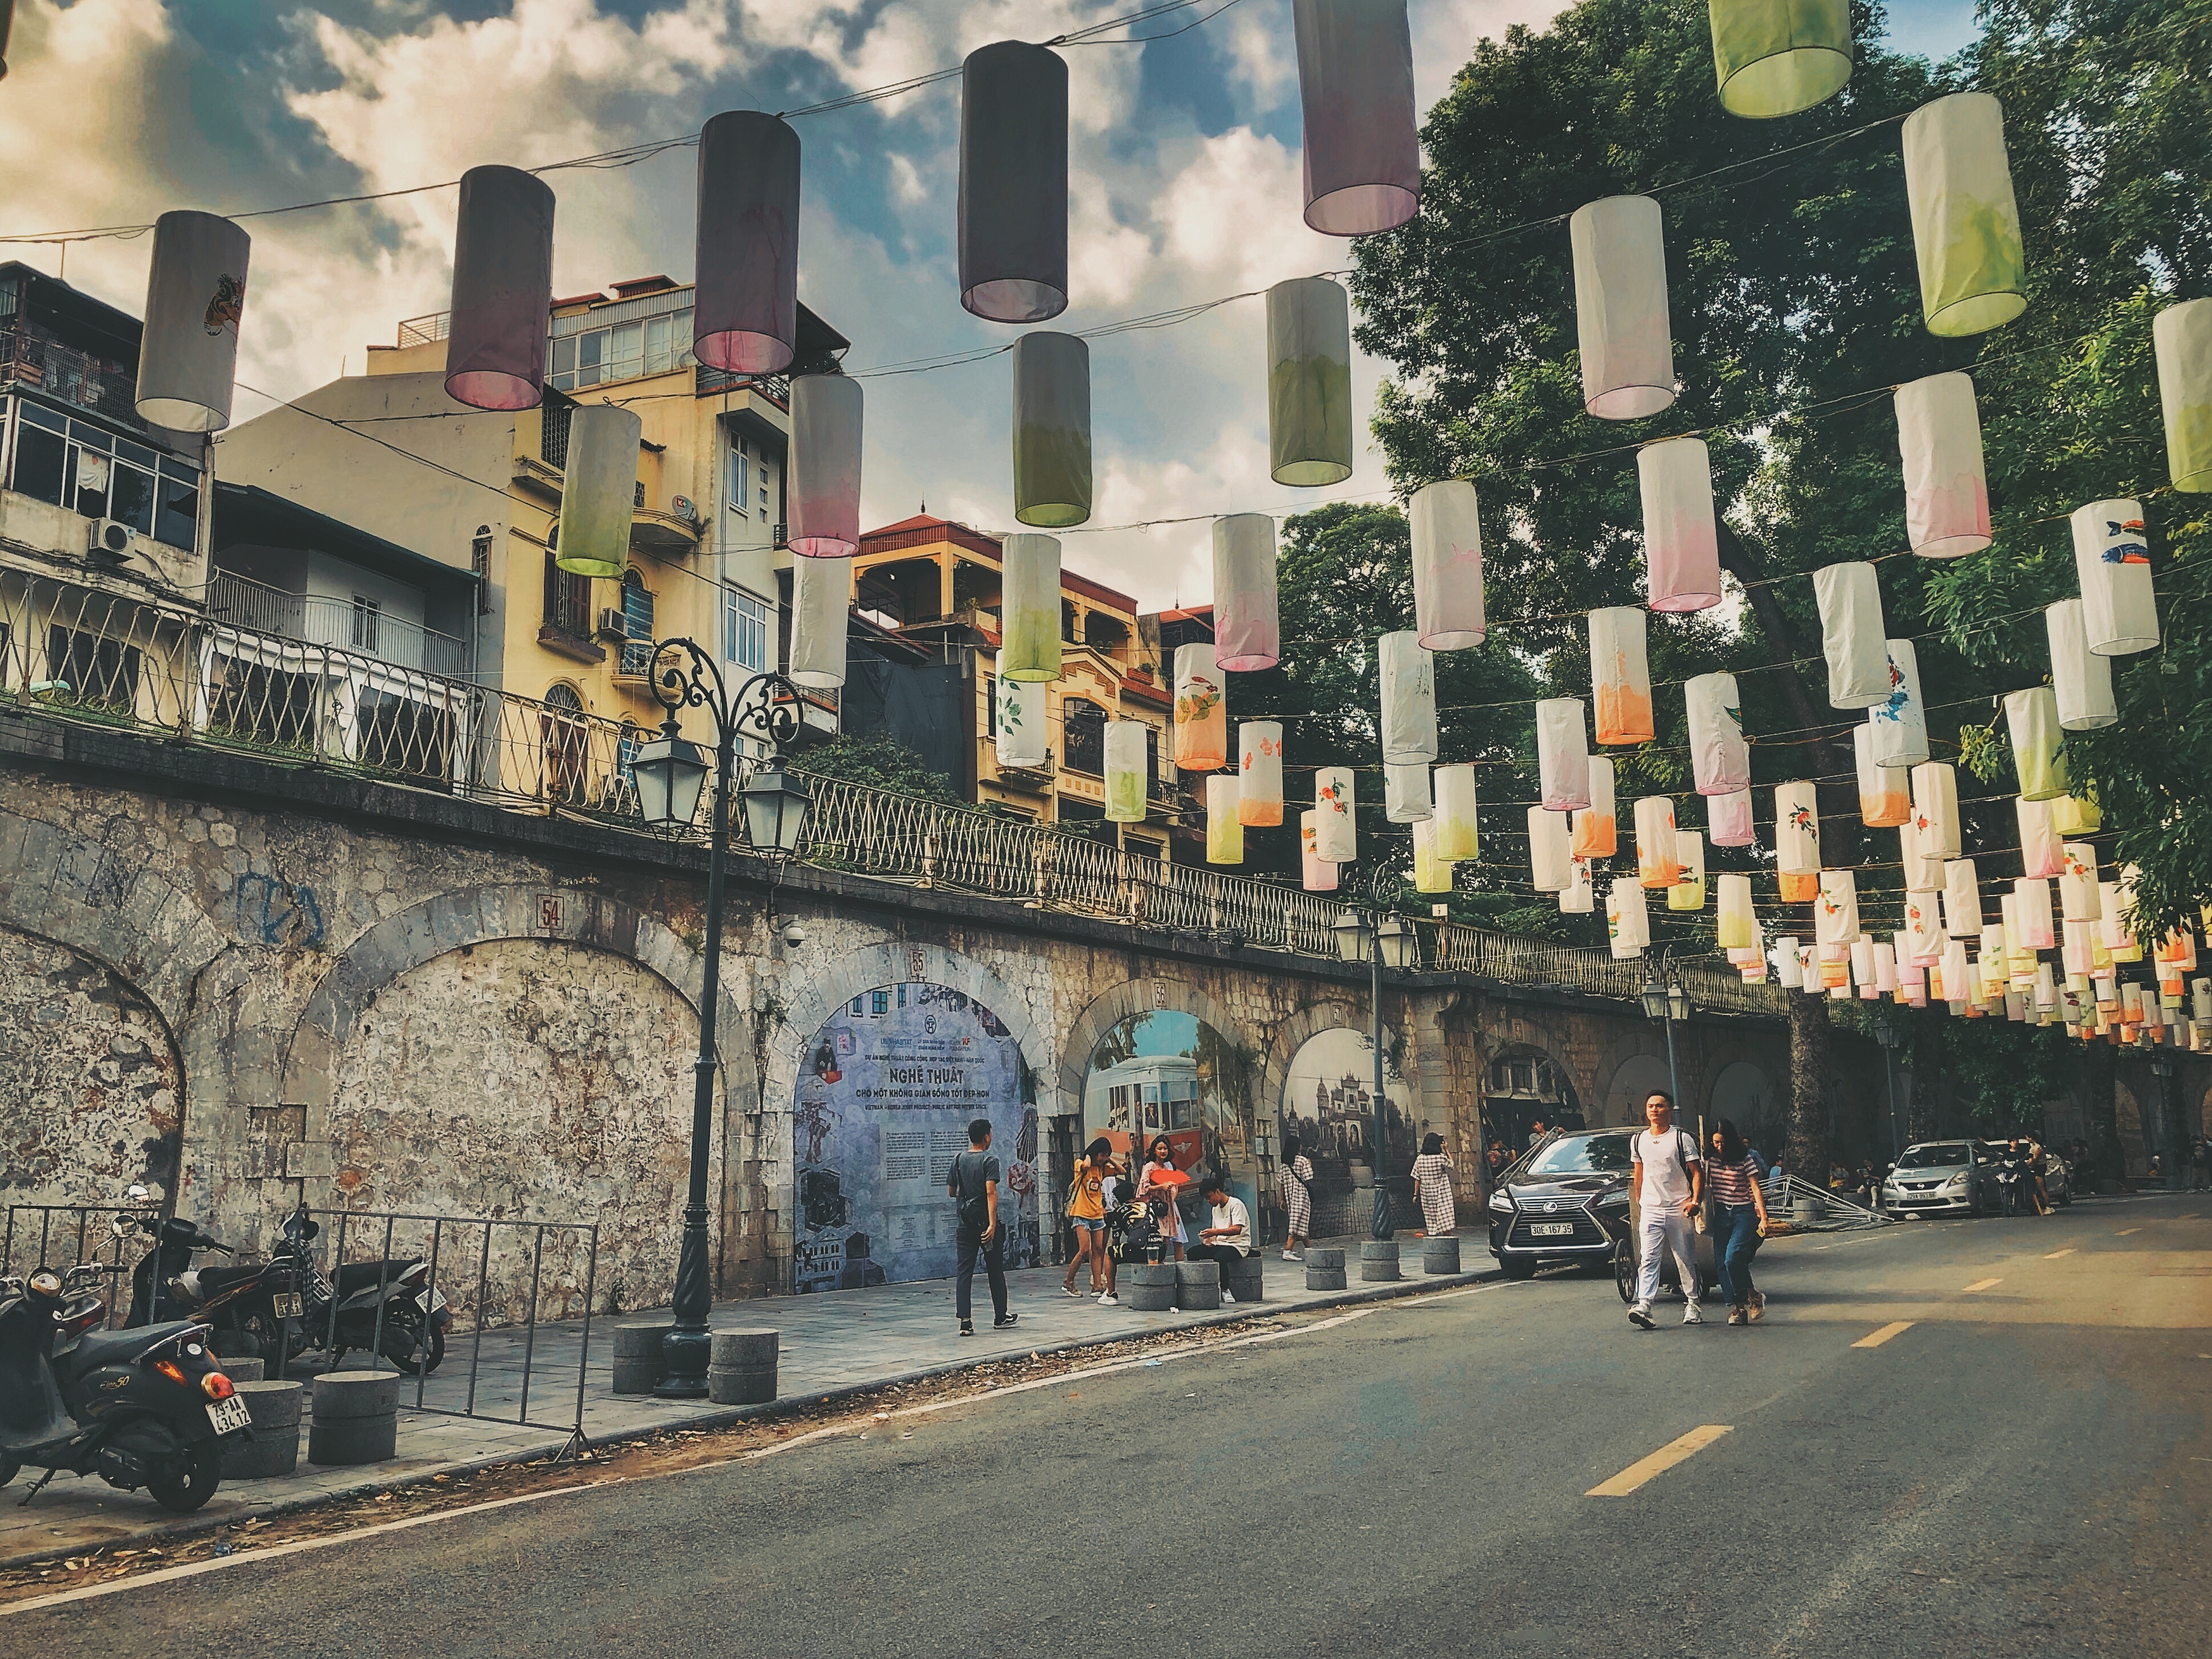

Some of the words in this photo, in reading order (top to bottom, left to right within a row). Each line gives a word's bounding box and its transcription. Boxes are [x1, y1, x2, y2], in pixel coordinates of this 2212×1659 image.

[543, 900, 560, 926] 54
[912, 952, 923, 971] 55
[1156, 986, 1165, 1003] 56
[889, 1065, 924, 1086] NGHỆ
[927, 1066, 963, 1085] THUẬT
[873, 1088, 888, 1100] MỘT
[889, 1088, 913, 1097] KHÔNG
[932, 1087, 950, 1098] SỐNG
[951, 1087, 962, 1098] TỐT
[212, 1397, 241, 1418] 29-AA
[216, 1410, 250, 1432] 434.12
